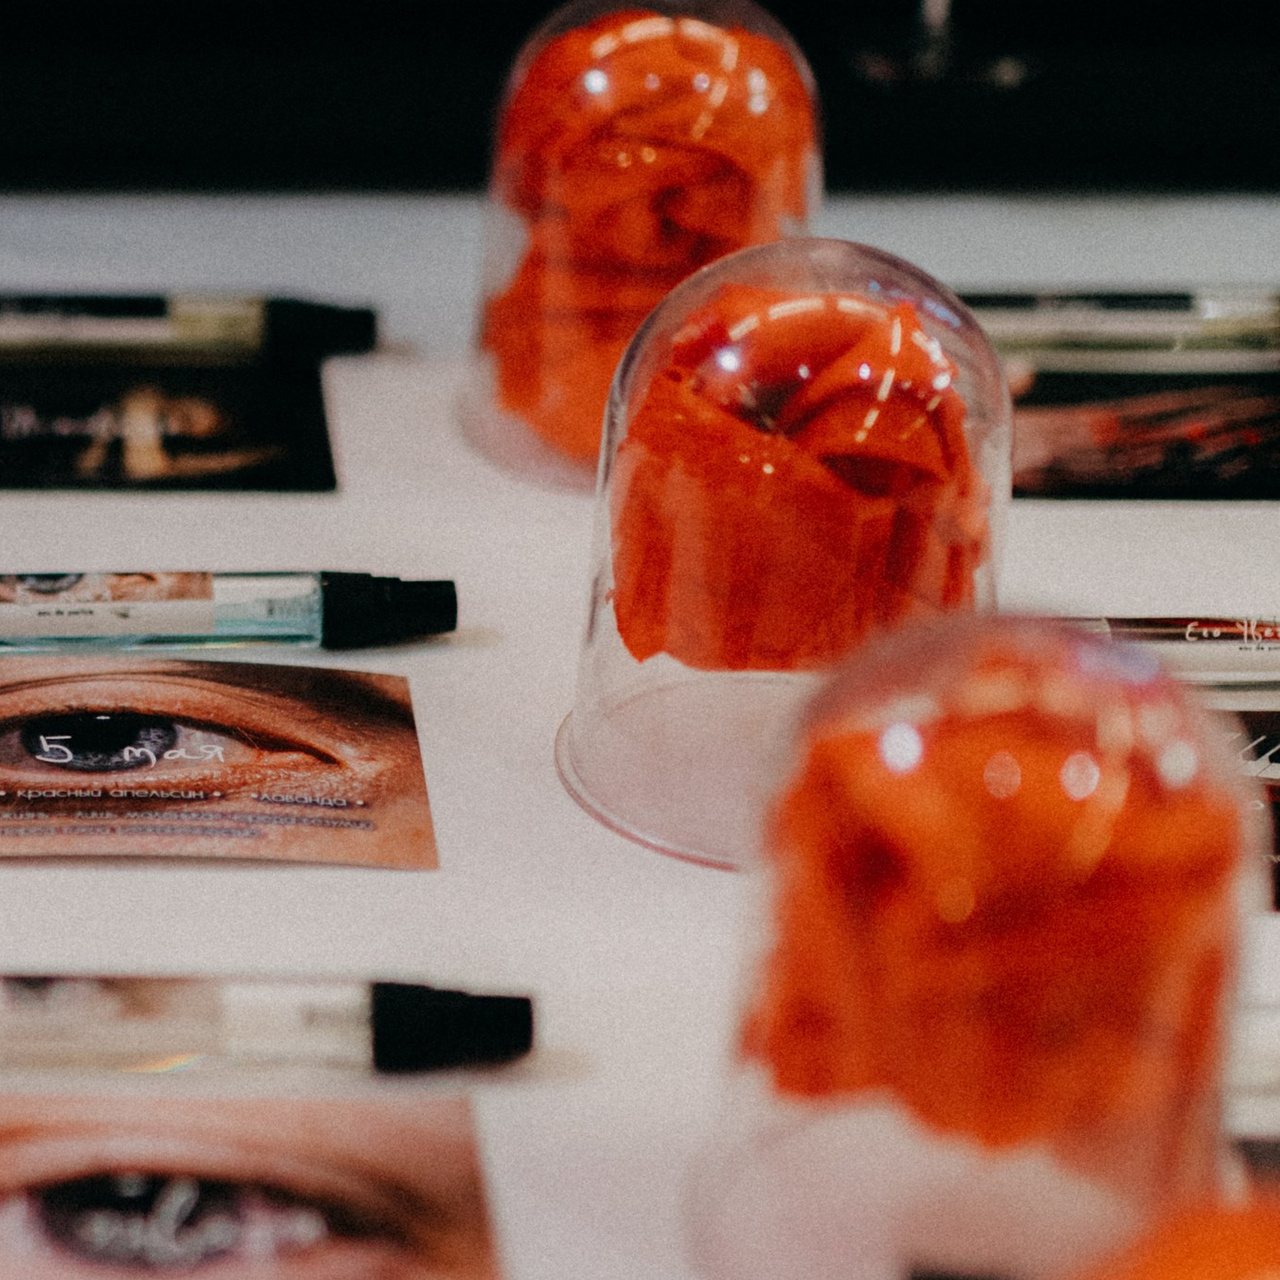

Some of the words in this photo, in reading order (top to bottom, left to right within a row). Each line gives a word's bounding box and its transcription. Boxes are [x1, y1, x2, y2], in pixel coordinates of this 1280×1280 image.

[35, 734, 73, 763] 5
[123, 745, 224, 768] мая
[16, 788, 102, 801] красный
[109, 789, 205, 799] апельсин
[260, 793, 348, 807] лаванда
